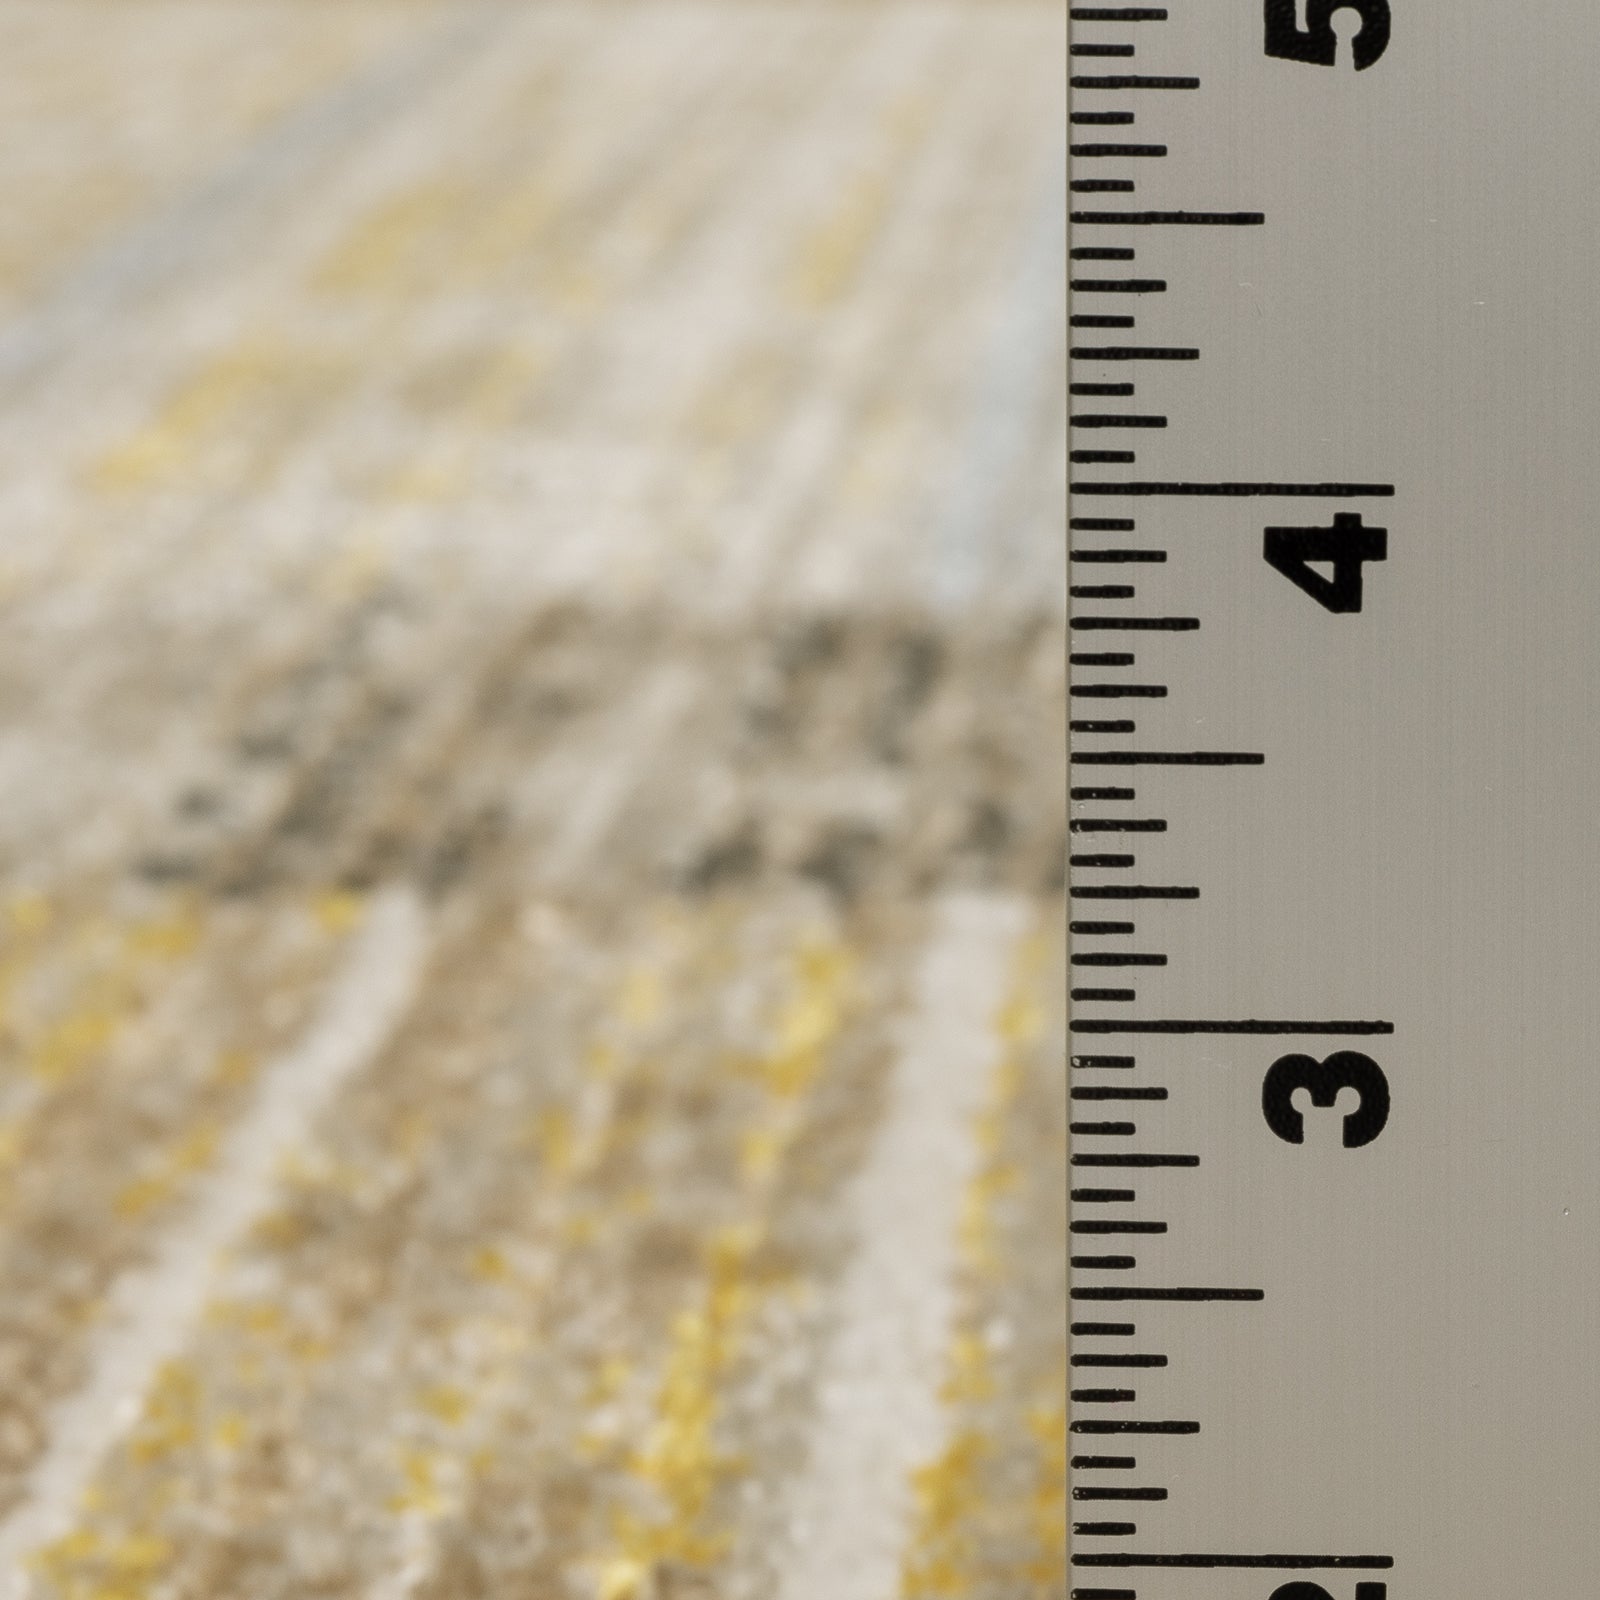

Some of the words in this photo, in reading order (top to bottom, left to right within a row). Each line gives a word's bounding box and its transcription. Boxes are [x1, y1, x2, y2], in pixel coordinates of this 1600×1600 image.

[1263, 0, 1391, 71] 5
[1262, 512, 1388, 614] 4
[1261, 1051, 1391, 1149] 3
